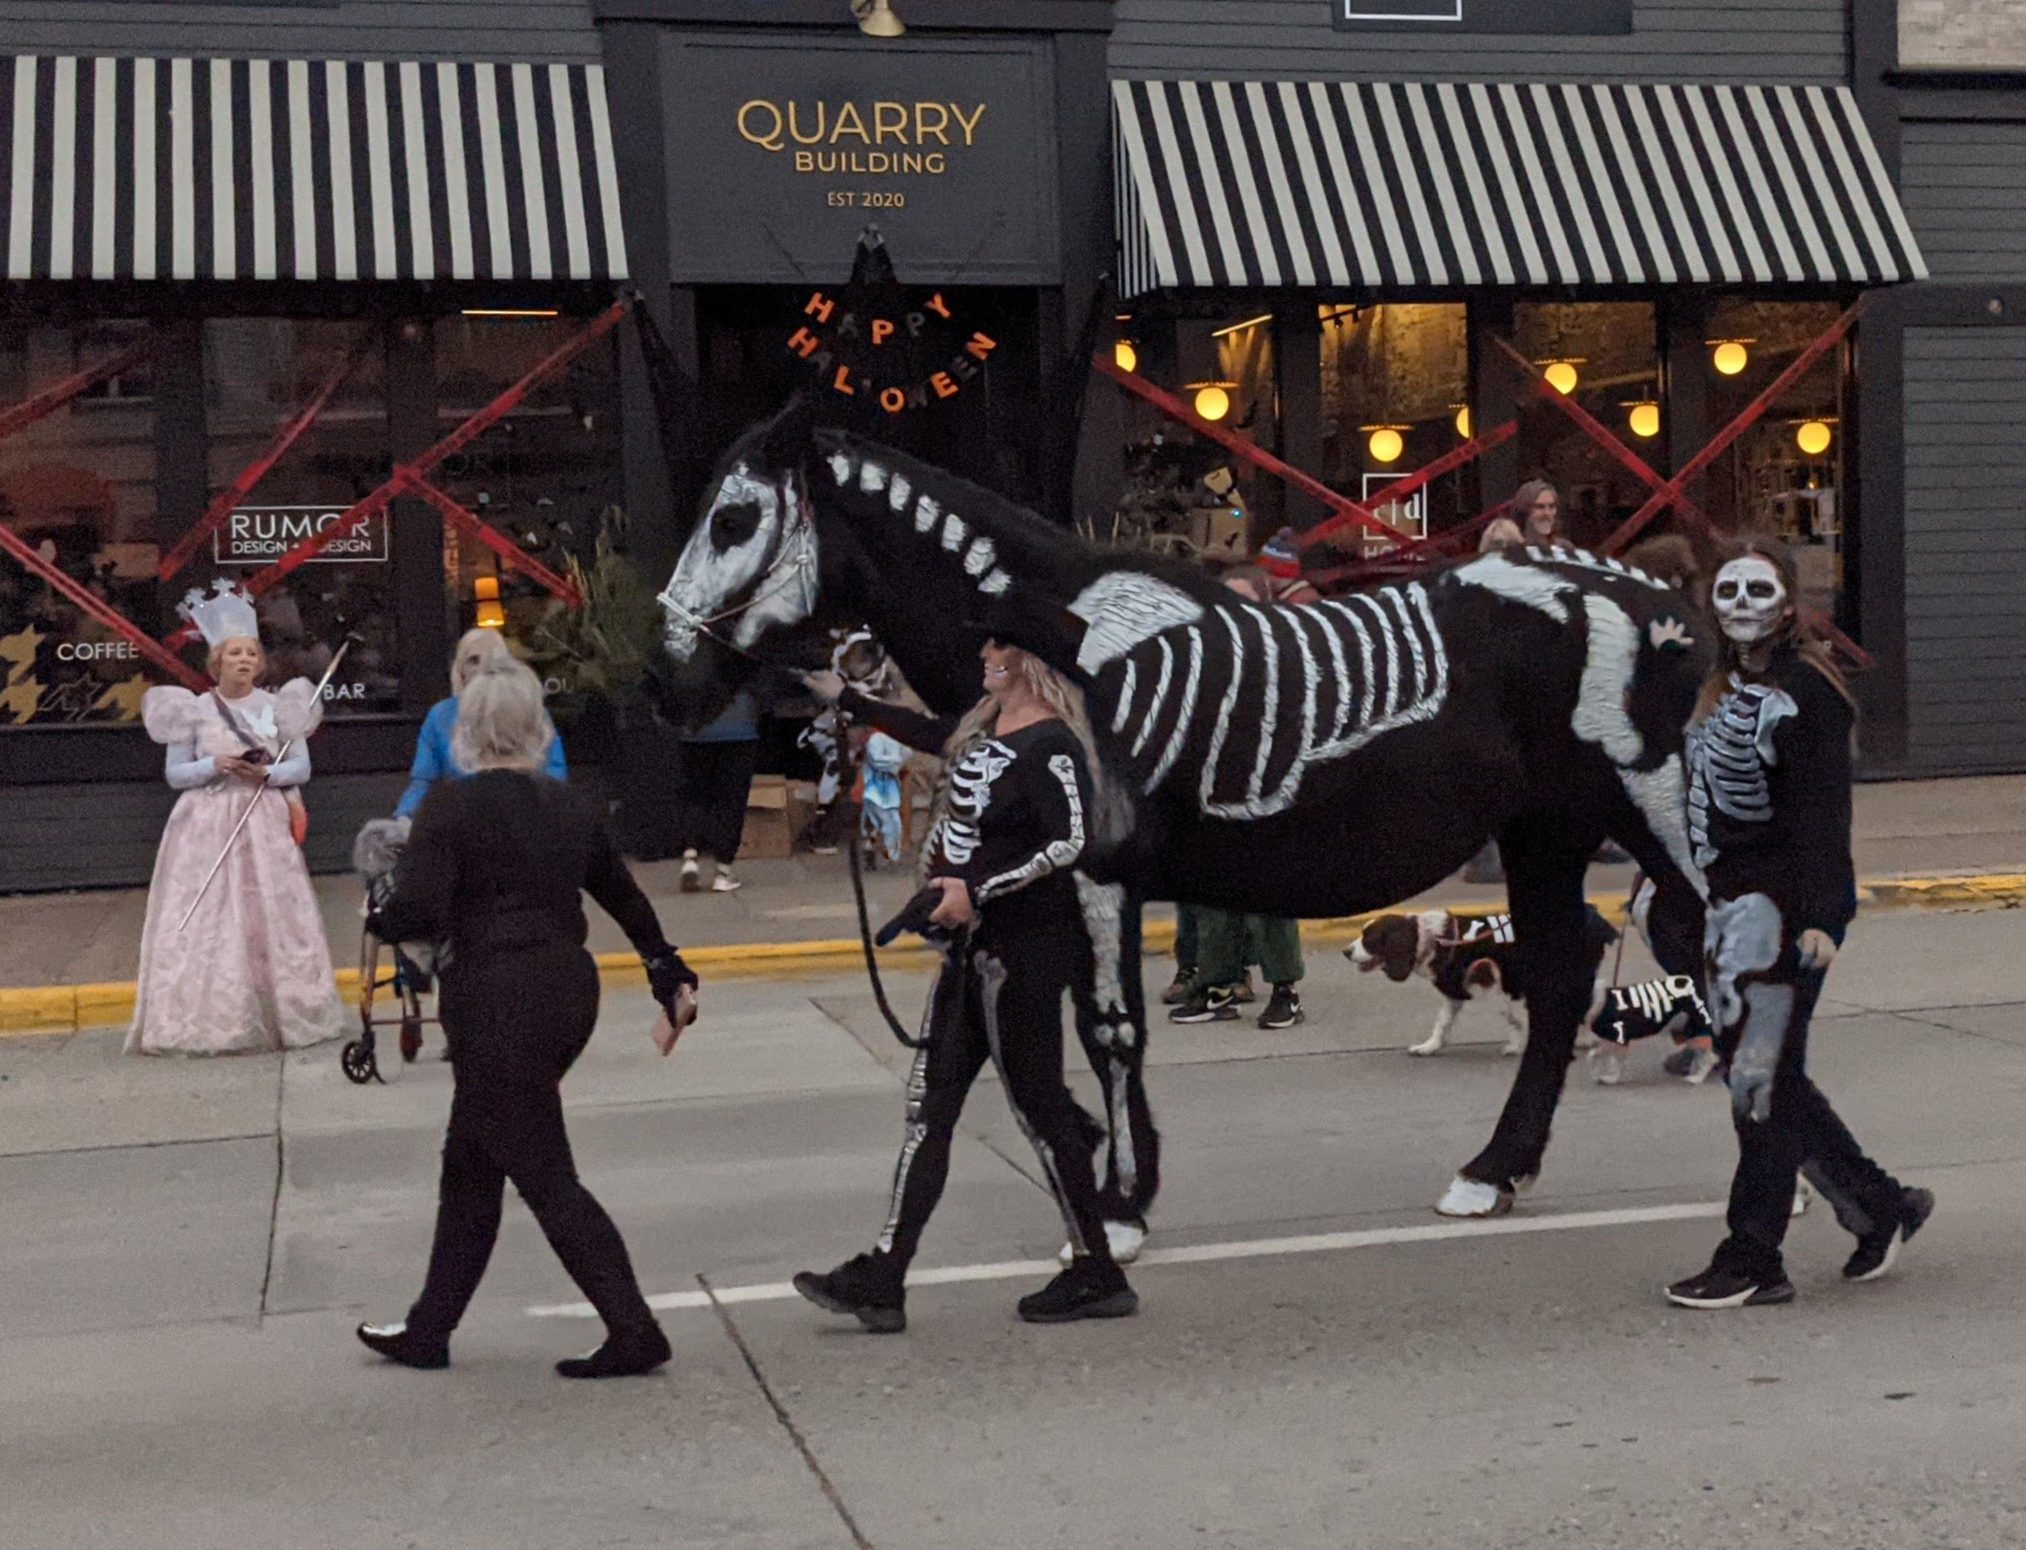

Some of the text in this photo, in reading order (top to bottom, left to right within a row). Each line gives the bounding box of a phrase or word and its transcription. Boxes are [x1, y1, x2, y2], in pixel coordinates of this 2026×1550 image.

[737, 99, 986, 151] QUARRY
[794, 151, 946, 174] BUILDING
[827, 191, 904, 207] EST 2020
[804, 291, 951, 345] HAPPY
[786, 326, 998, 413] HALOWEEN
[231, 513, 370, 539] RUMOR
[231, 540, 288, 554] DESIGN
[56, 642, 139, 661] COFFEE
[323, 683, 366, 700] BAR
